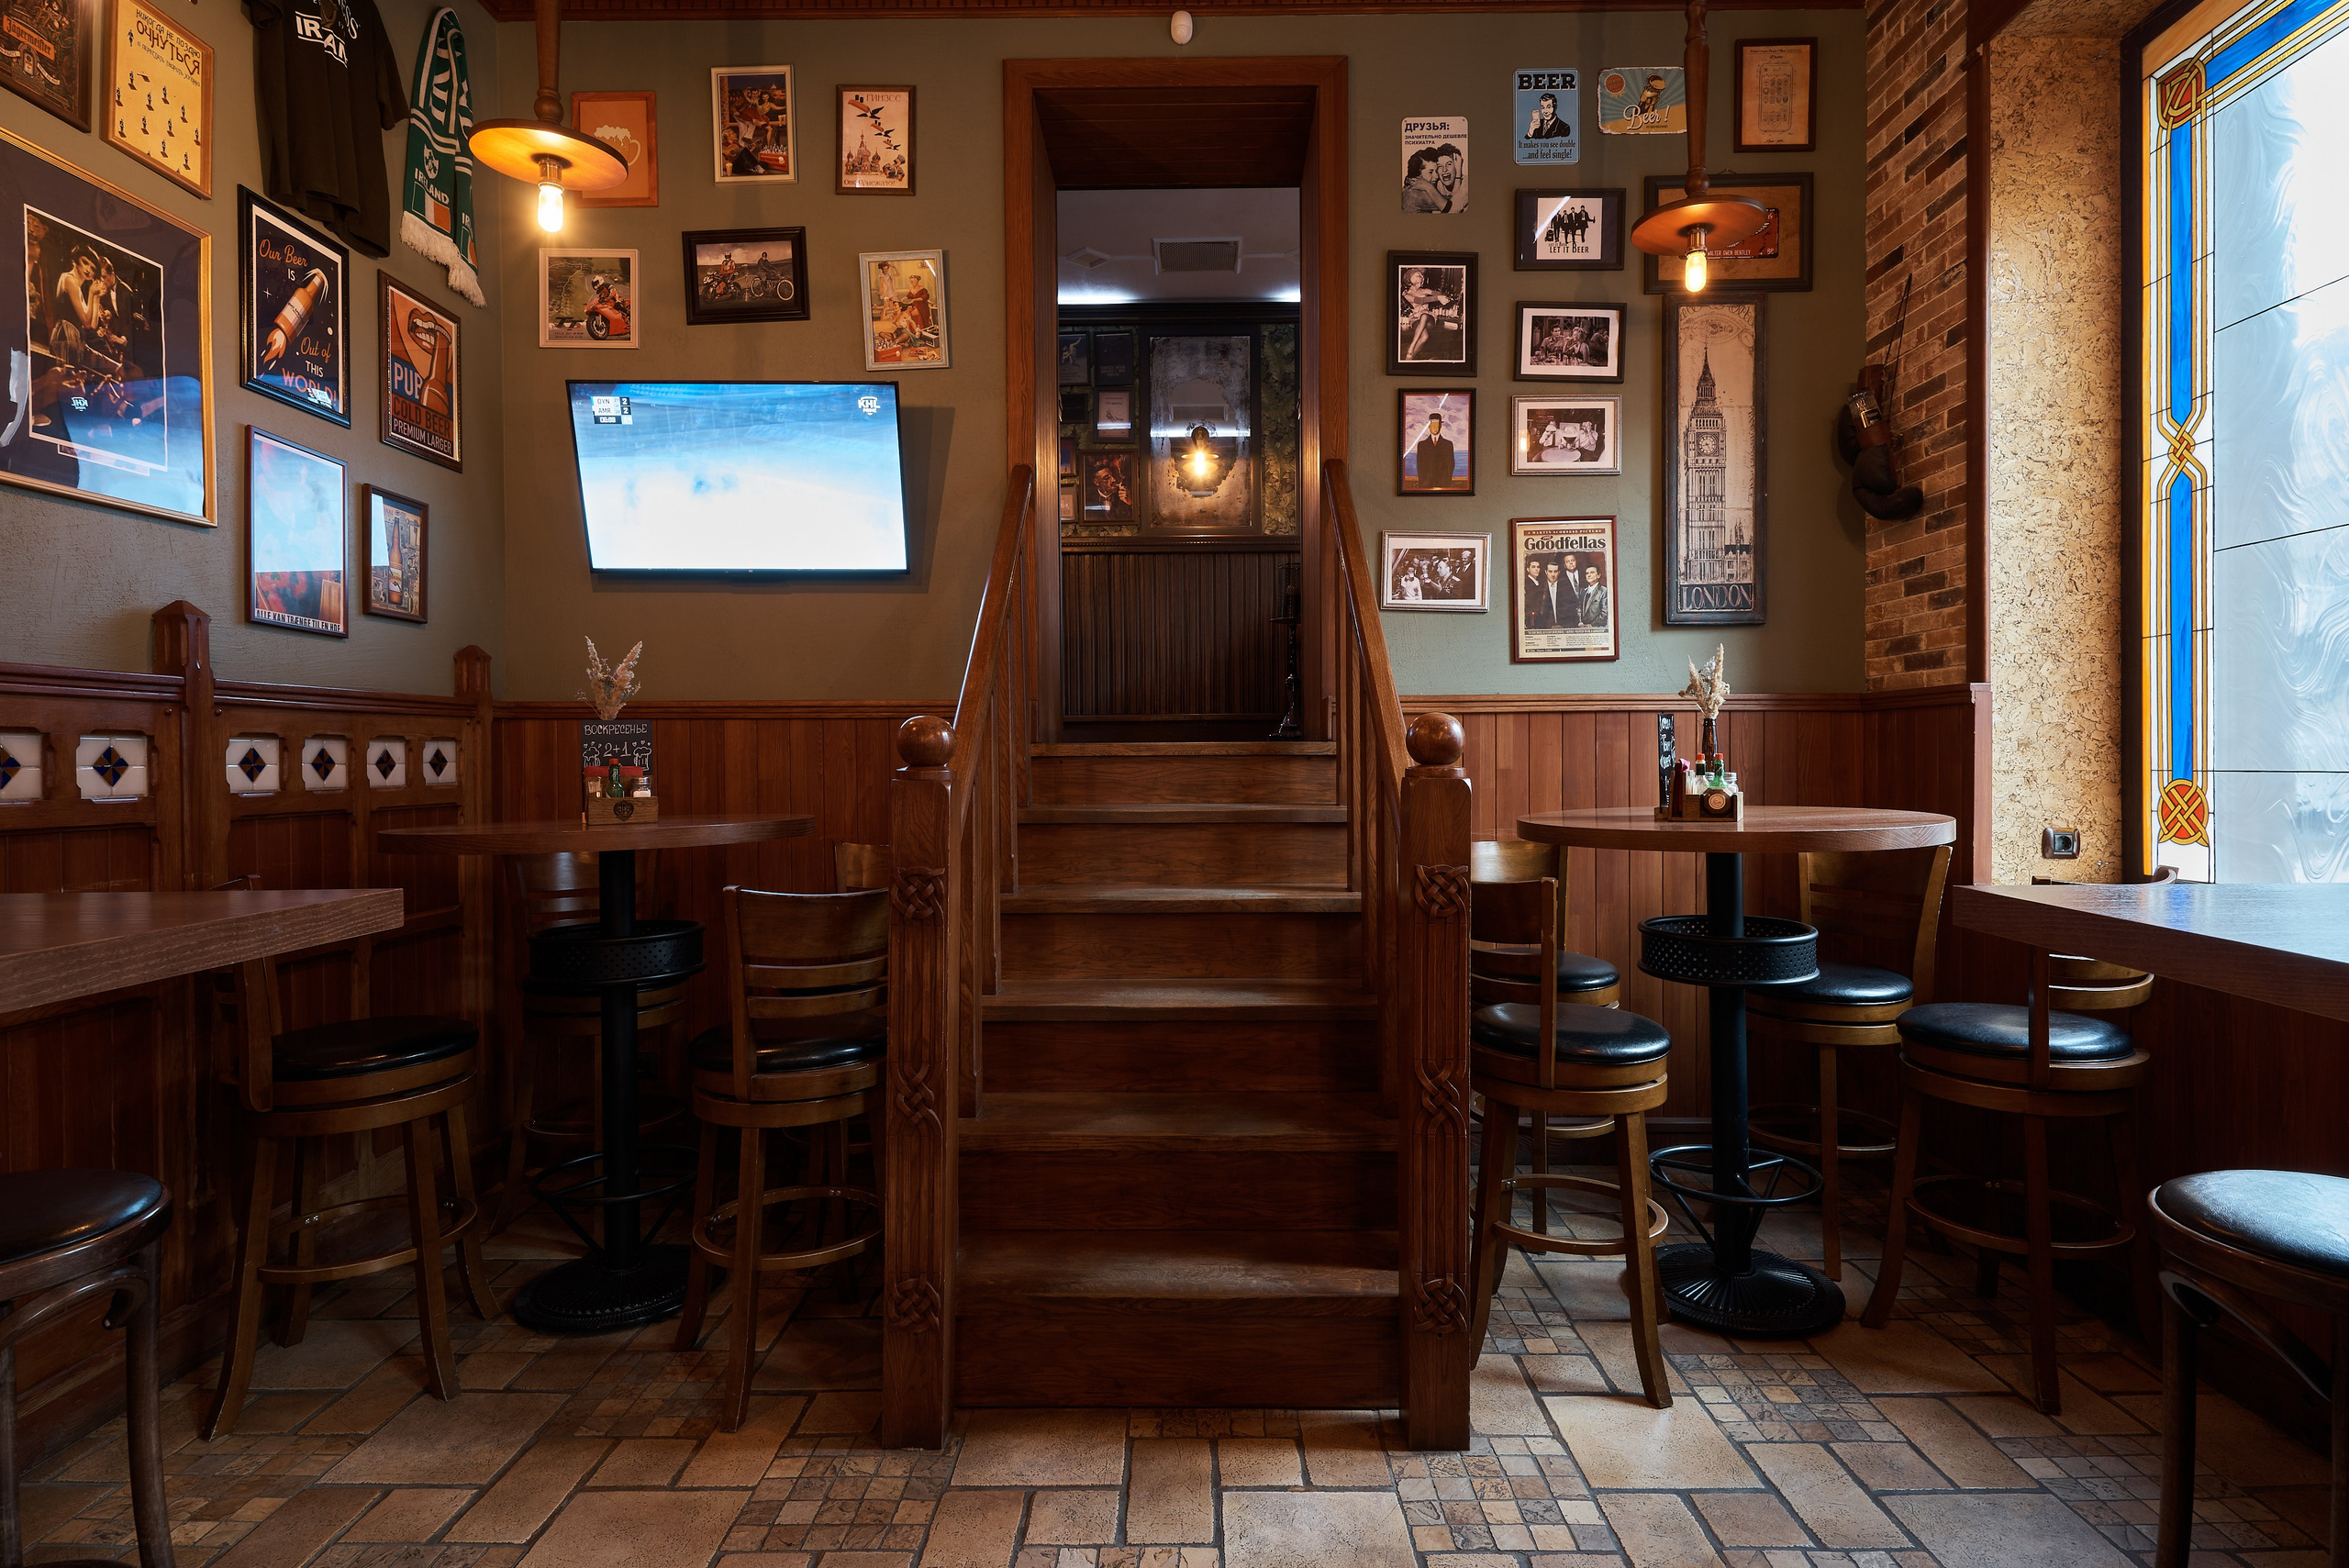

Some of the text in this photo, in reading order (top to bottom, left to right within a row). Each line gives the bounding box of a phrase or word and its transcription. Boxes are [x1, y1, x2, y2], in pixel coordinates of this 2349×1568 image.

[137, 9, 200, 59] НИКОГДА НЕ ПОЗДНО
[137, 20, 200, 75] ОЧНУТЬСЯ
[1519, 73, 1576, 91] BEER
[1405, 122, 1450, 132] ДРУЗЬЯ:
[1523, 140, 1539, 149] makes
[1560, 139, 1575, 148] double
[1541, 150, 1551, 159] feel
[1553, 149, 1572, 160] single!
[259, 239, 308, 267] Our Beer
[287, 268, 295, 281] IS
[301, 337, 331, 363] Out of
[306, 361, 324, 377] THIS
[394, 361, 423, 400] PUB
[858, 399, 881, 408] KHL
[394, 396, 450, 439] COLD BEER
[394, 417, 451, 454] PREMIUM LARGER
[1524, 536, 1606, 550] Goodfellas
[1682, 584, 1752, 609] LONDON
[257, 609, 340, 631] ALLE KAN TRÆNGE TIL EN HOF
[584, 724, 648, 735] ВОСКРЕСЕНЬЕ
[603, 741, 631, 758] 2+1
